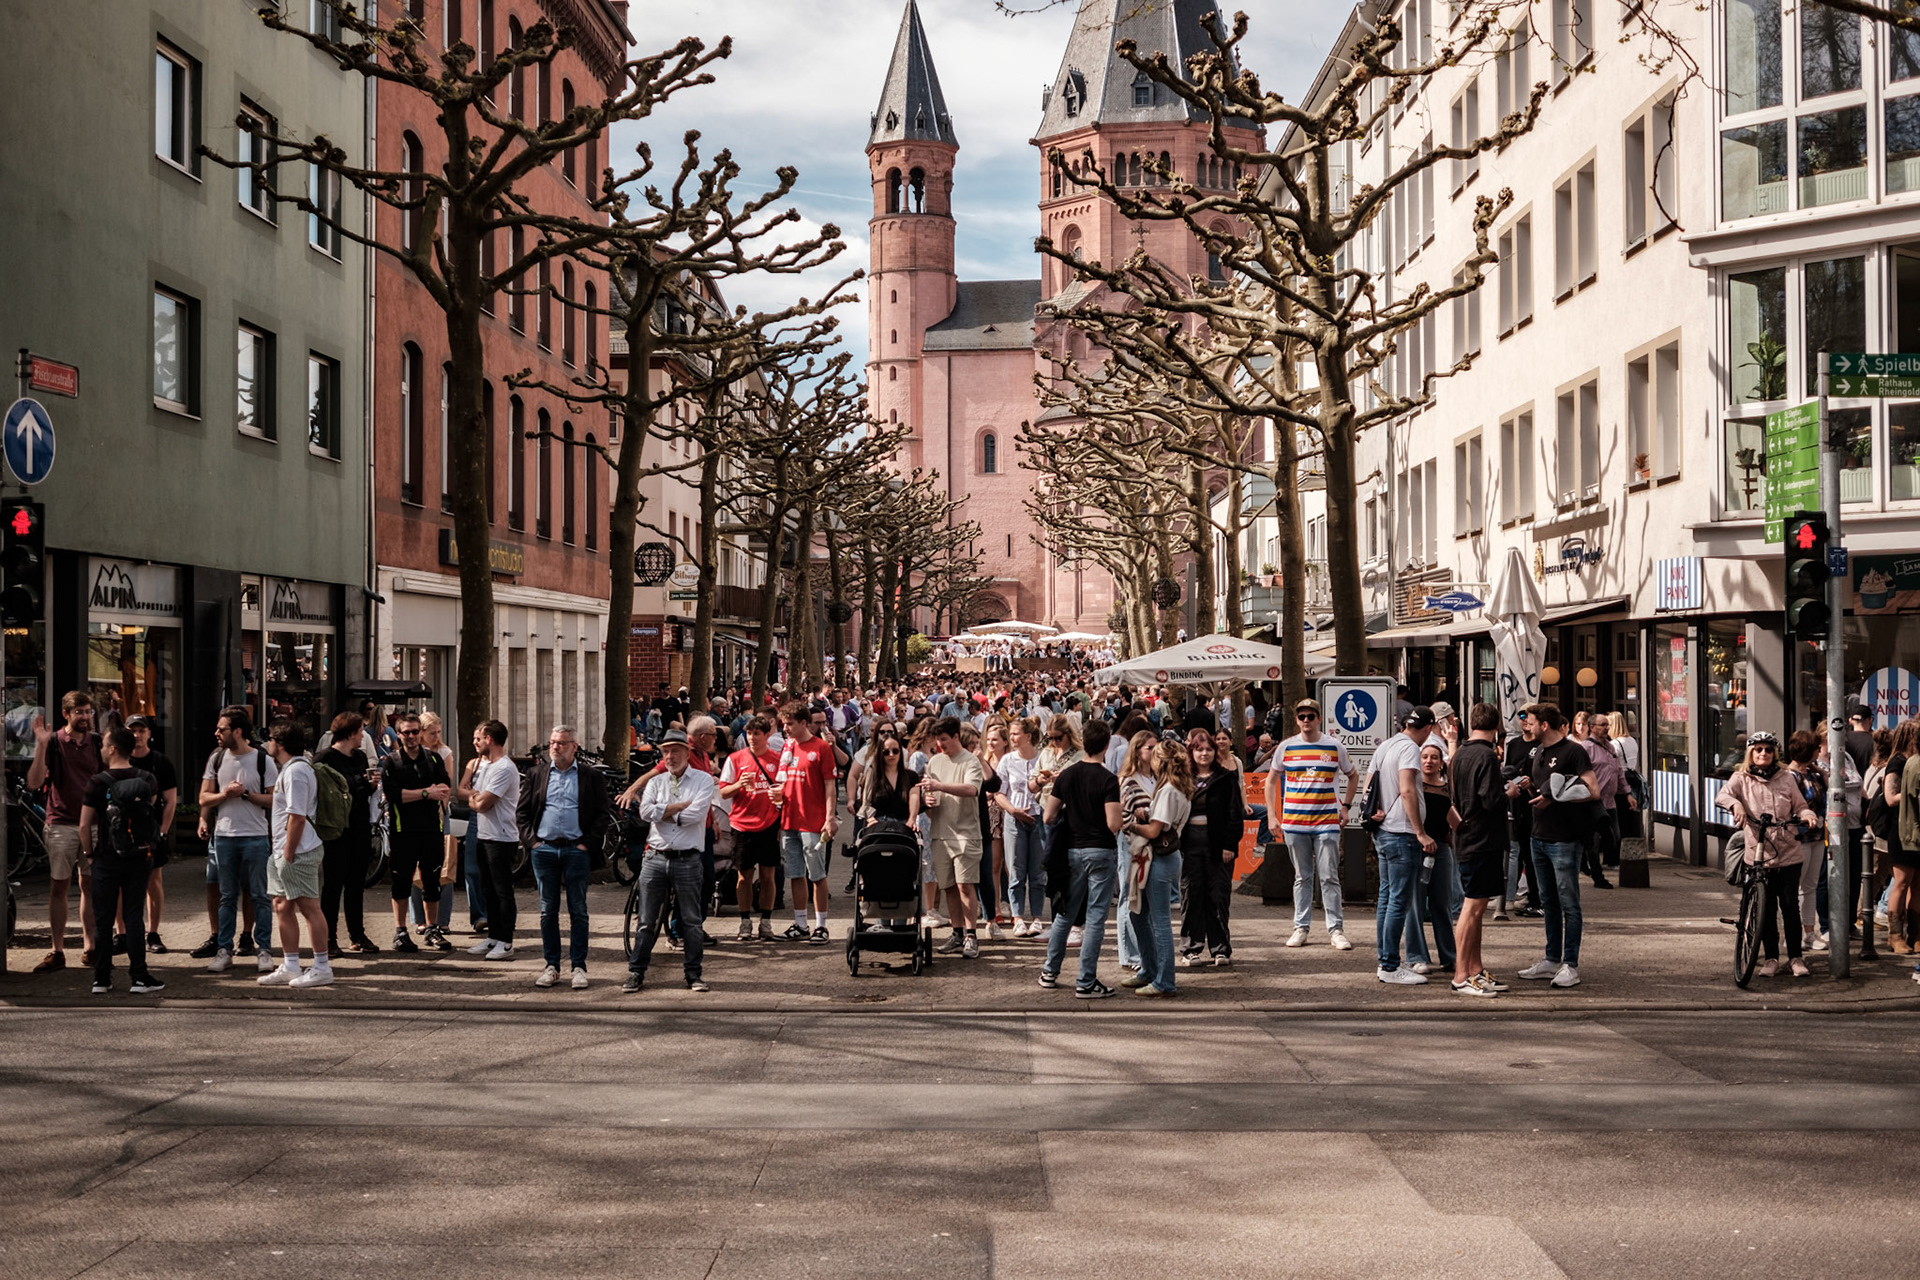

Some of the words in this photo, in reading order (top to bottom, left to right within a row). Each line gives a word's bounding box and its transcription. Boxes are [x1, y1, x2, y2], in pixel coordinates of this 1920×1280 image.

[1878, 378, 1912, 387] Rathaus
[1670, 565, 1685, 581] NINO
[94, 585, 135, 609] ALPIN
[1666, 585, 1689, 601] PANINO
[272, 600, 302, 620] ALPIN
[1187, 653, 1267, 662] BINDING
[1170, 670, 1204, 680] BINDING
[1876, 688, 1911, 700] NINO
[1868, 703, 1920, 716] PANINO
[1340, 734, 1373, 746] ZONE
